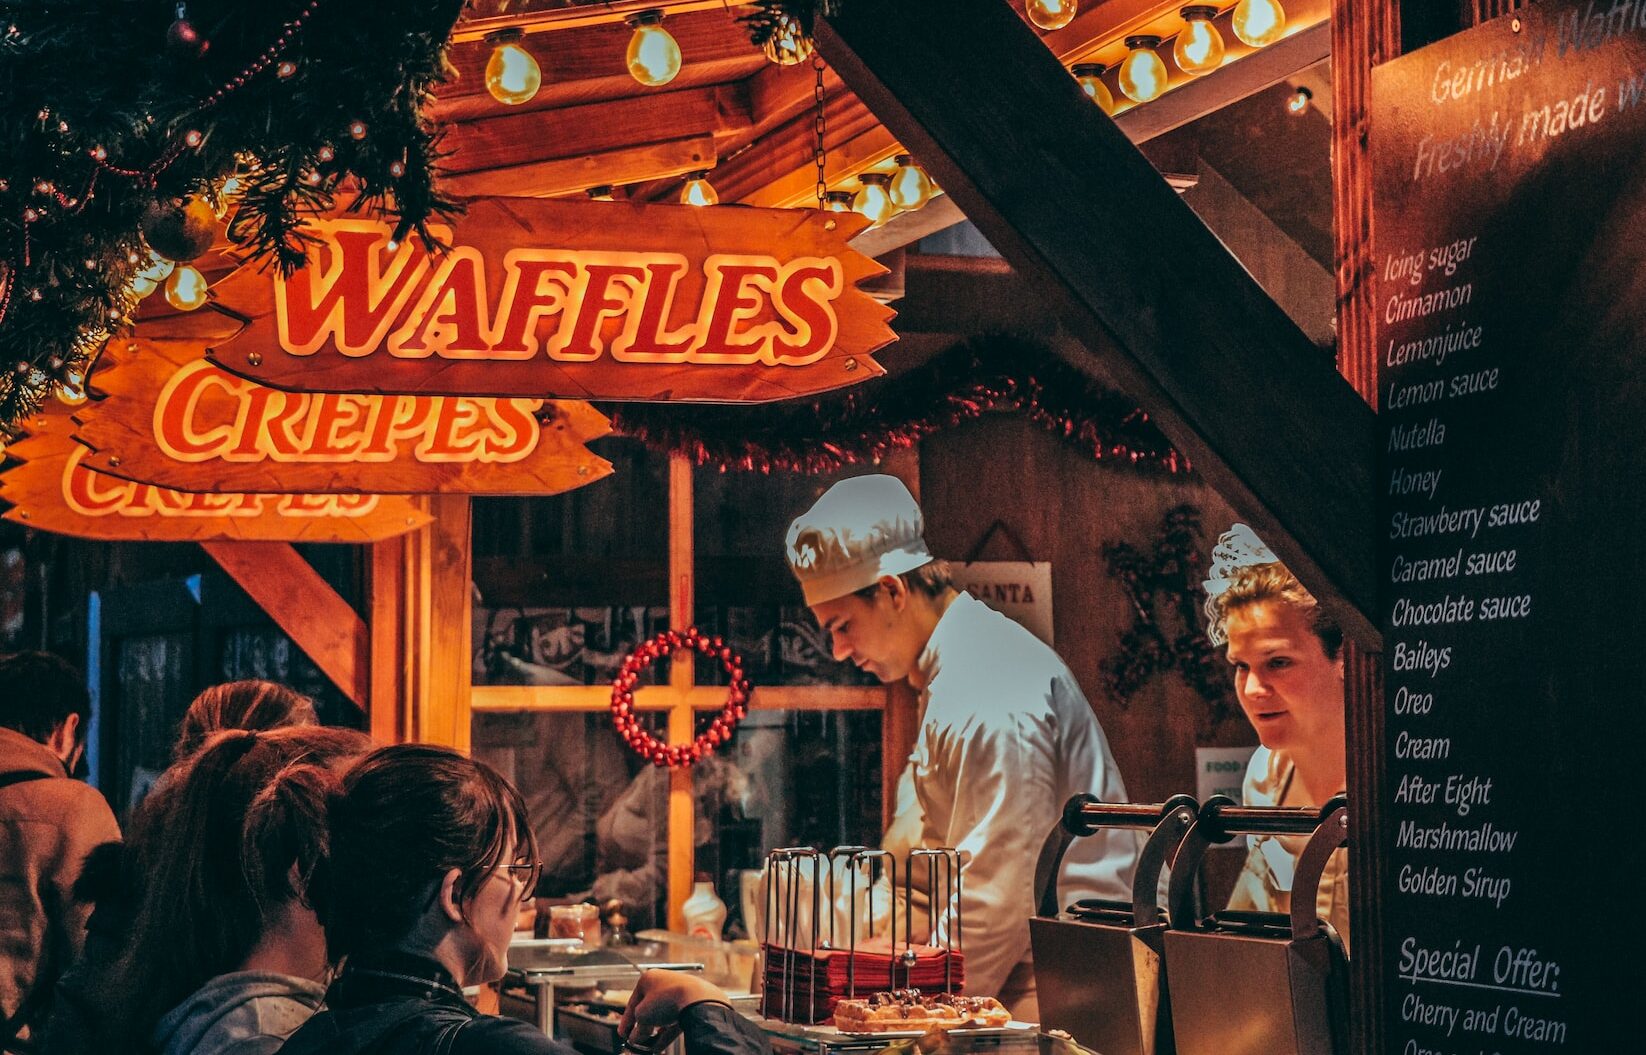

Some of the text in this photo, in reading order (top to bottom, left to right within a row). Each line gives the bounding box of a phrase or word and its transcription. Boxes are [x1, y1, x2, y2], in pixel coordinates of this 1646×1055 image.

[1413, 111, 1511, 181] Freshly
[1518, 80, 1606, 147] made
[1384, 236, 1477, 285] Icing sugar
[276, 221, 841, 365] WAFFLES
[1385, 282, 1472, 325] Cinnamon
[1386, 321, 1483, 367] Lemonjuice
[1388, 367, 1500, 410] Lemon sauce
[154, 360, 540, 463] CREPES
[1387, 418, 1446, 453] Nutella
[1389, 466, 1442, 500] Honey
[1390, 498, 1541, 539] Strawberry sauce
[1391, 548, 1517, 583] Caramel sauce
[966, 583, 1034, 603] SANTA
[1392, 593, 1532, 627] Chocolate sauce
[1393, 640, 1452, 678] Baileys
[1394, 685, 1433, 715] Oreo
[1395, 730, 1451, 760] Cream
[1394, 774, 1493, 816] After Eight
[1396, 820, 1519, 853] Marshmallow
[1398, 864, 1511, 910] Golden Sirup
[1399, 936, 1561, 991] Special Offer:
[1401, 993, 1567, 1044] Cherry and Cream
